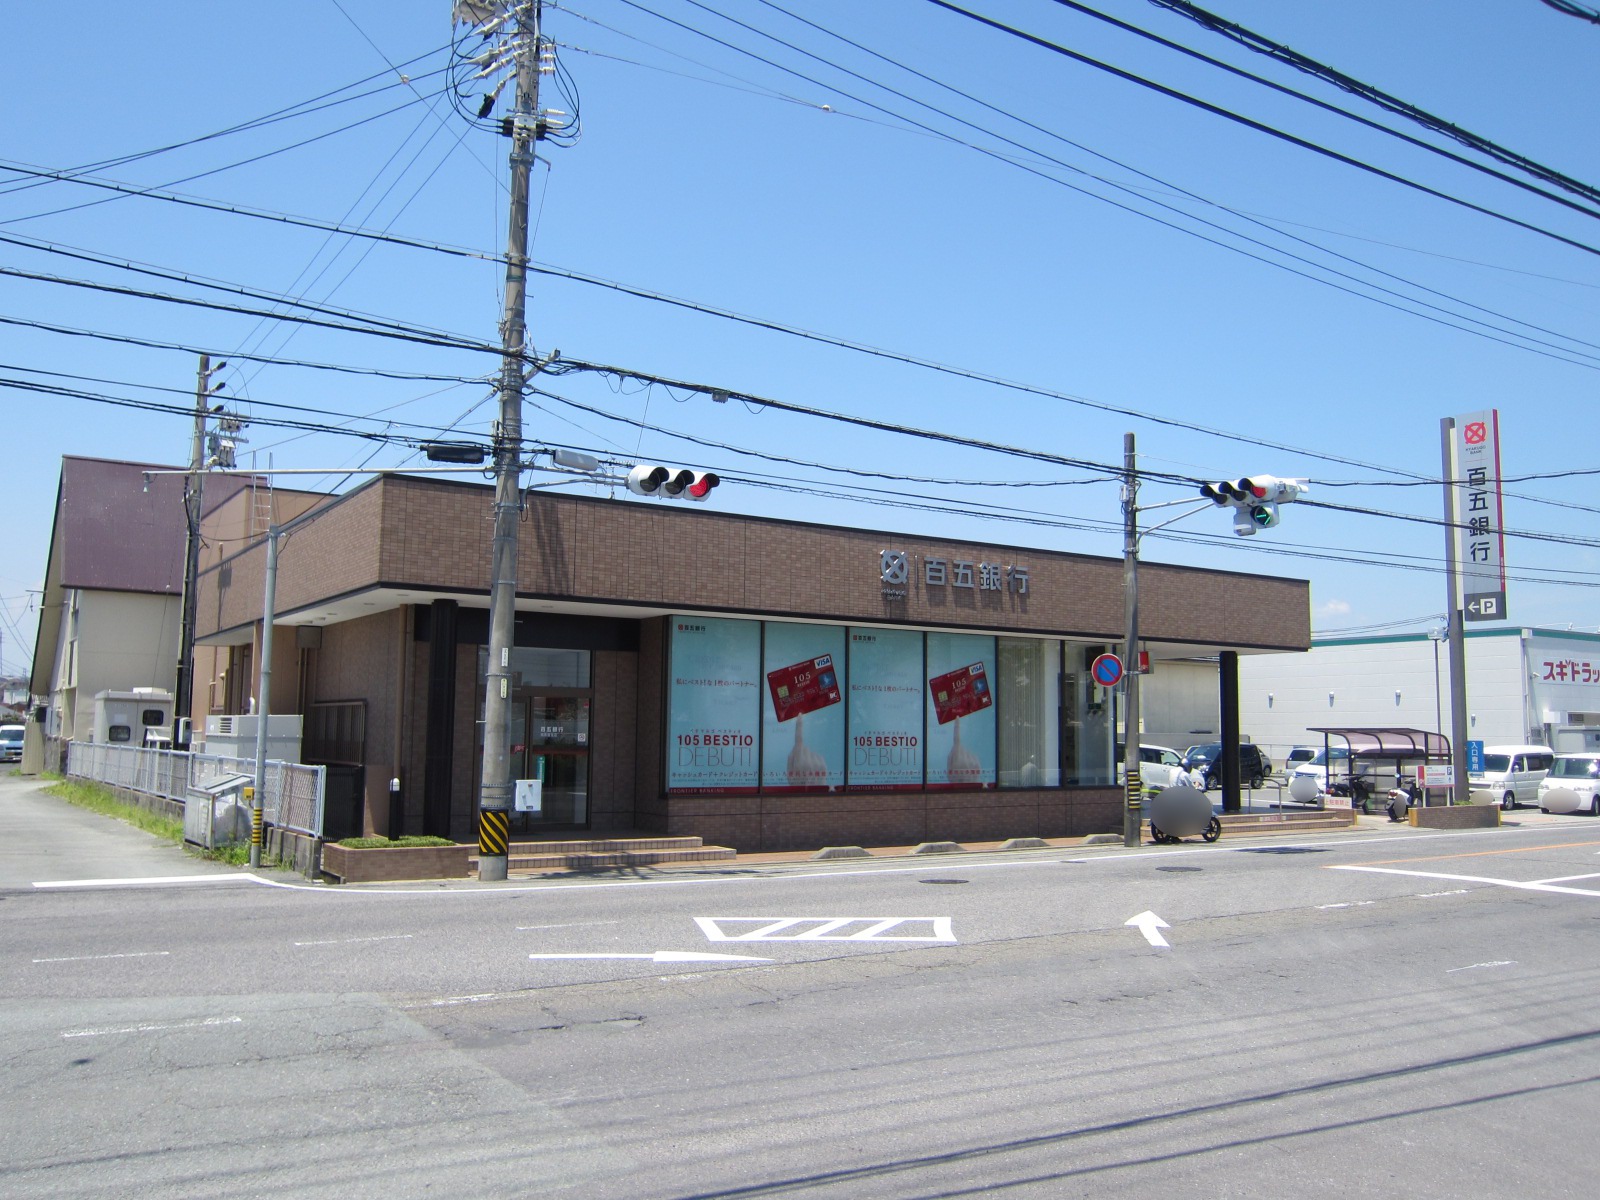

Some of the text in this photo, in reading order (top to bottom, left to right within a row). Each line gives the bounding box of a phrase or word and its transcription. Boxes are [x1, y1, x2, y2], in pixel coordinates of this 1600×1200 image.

[1467, 467, 1490, 562] 百五銀行
[924, 556, 1028, 594] 百五銀行
[1483, 600, 1494, 613] P
[816, 657, 830, 667] VISA
[971, 665, 983, 674] VISA
[1543, 659, 1600, 683] スギドラッ
[794, 671, 811, 685] 105
[952, 678, 967, 690] 105
[677, 734, 753, 747] 105 BESTIO
[853, 736, 918, 747] 105 BESTIO
[678, 746, 752, 767] DEBUT!
[854, 747, 917, 767] DEBUT!
[1471, 741, 1479, 771] 入口専用
